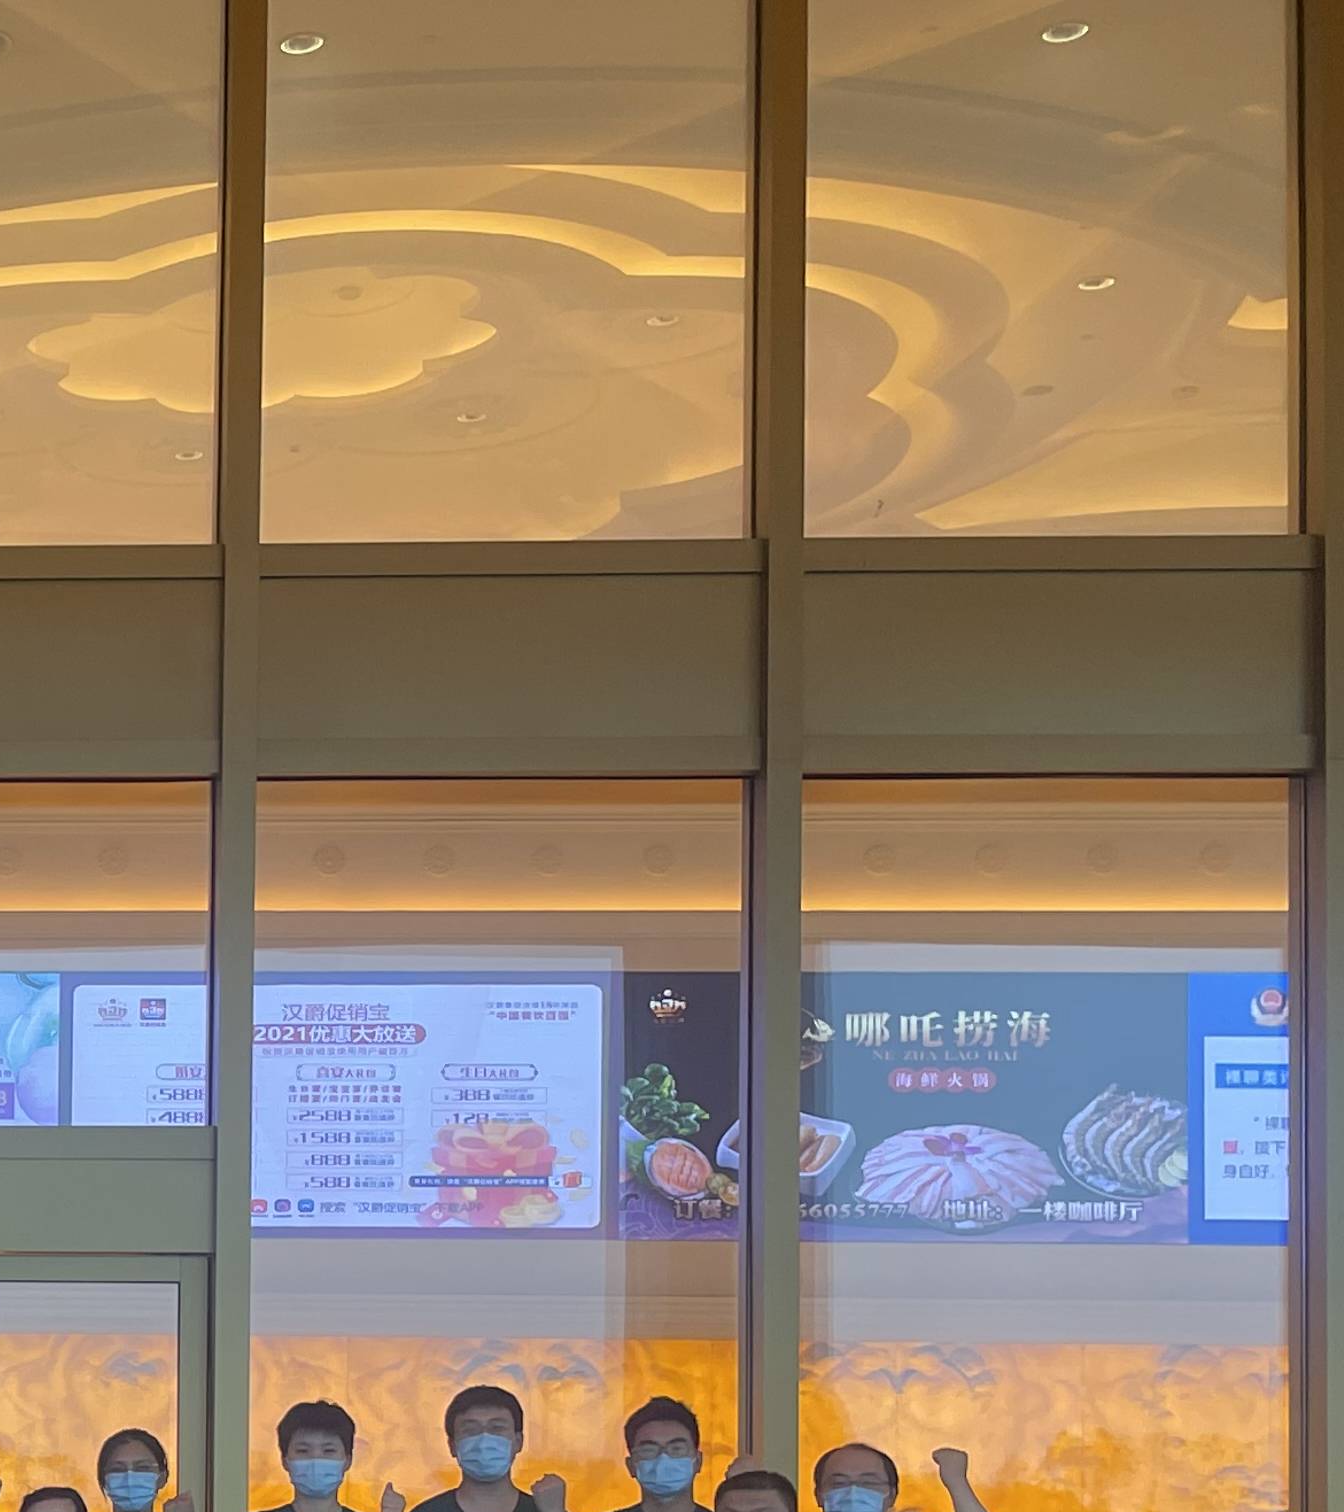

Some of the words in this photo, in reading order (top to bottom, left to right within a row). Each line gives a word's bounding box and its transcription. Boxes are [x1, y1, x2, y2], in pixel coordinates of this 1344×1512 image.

[282, 1003, 390, 1021] 汉爵促销宝
[254, 1026, 417, 1043] 2021优惠大放送
[845, 1011, 1052, 1047] 哪吒捞海
